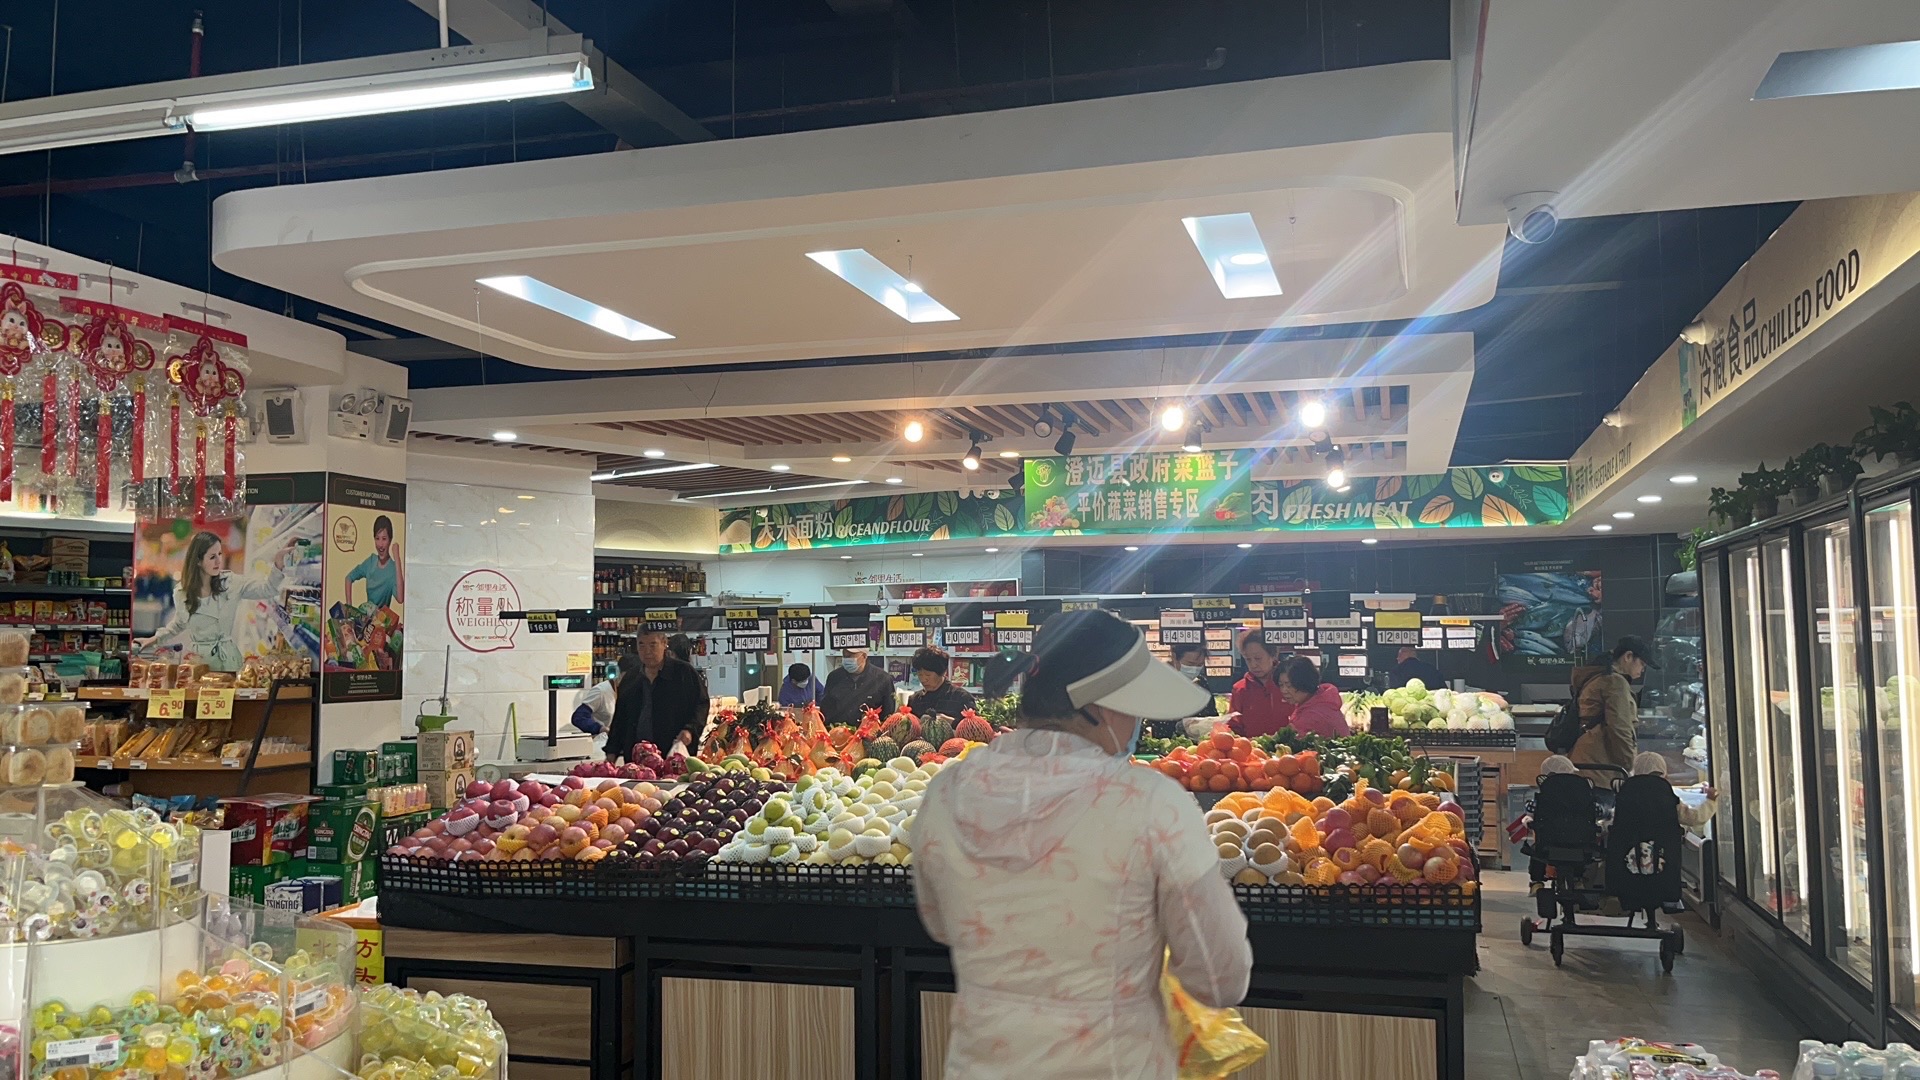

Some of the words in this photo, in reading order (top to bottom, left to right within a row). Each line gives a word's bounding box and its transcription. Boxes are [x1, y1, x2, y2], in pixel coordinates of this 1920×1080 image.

[1760, 288, 1812, 360] CHILLED
[1815, 248, 1860, 318] FOOD
[1698, 297, 1758, 405] 冷藏食品
[1065, 450, 1239, 486] 澄迈县政府菜篮子
[1077, 488, 1200, 522] 平价蔬菜销售专区
[1250, 486, 1279, 520] 肉
[1284, 502, 1350, 521] FRESH
[1353, 501, 1413, 518] MEAT
[757, 511, 835, 543] 大米面粉
[456, 617, 513, 627] WEIGHING
[159, 700, 183, 717] 6.90
[202, 700, 226, 715] 3.50
